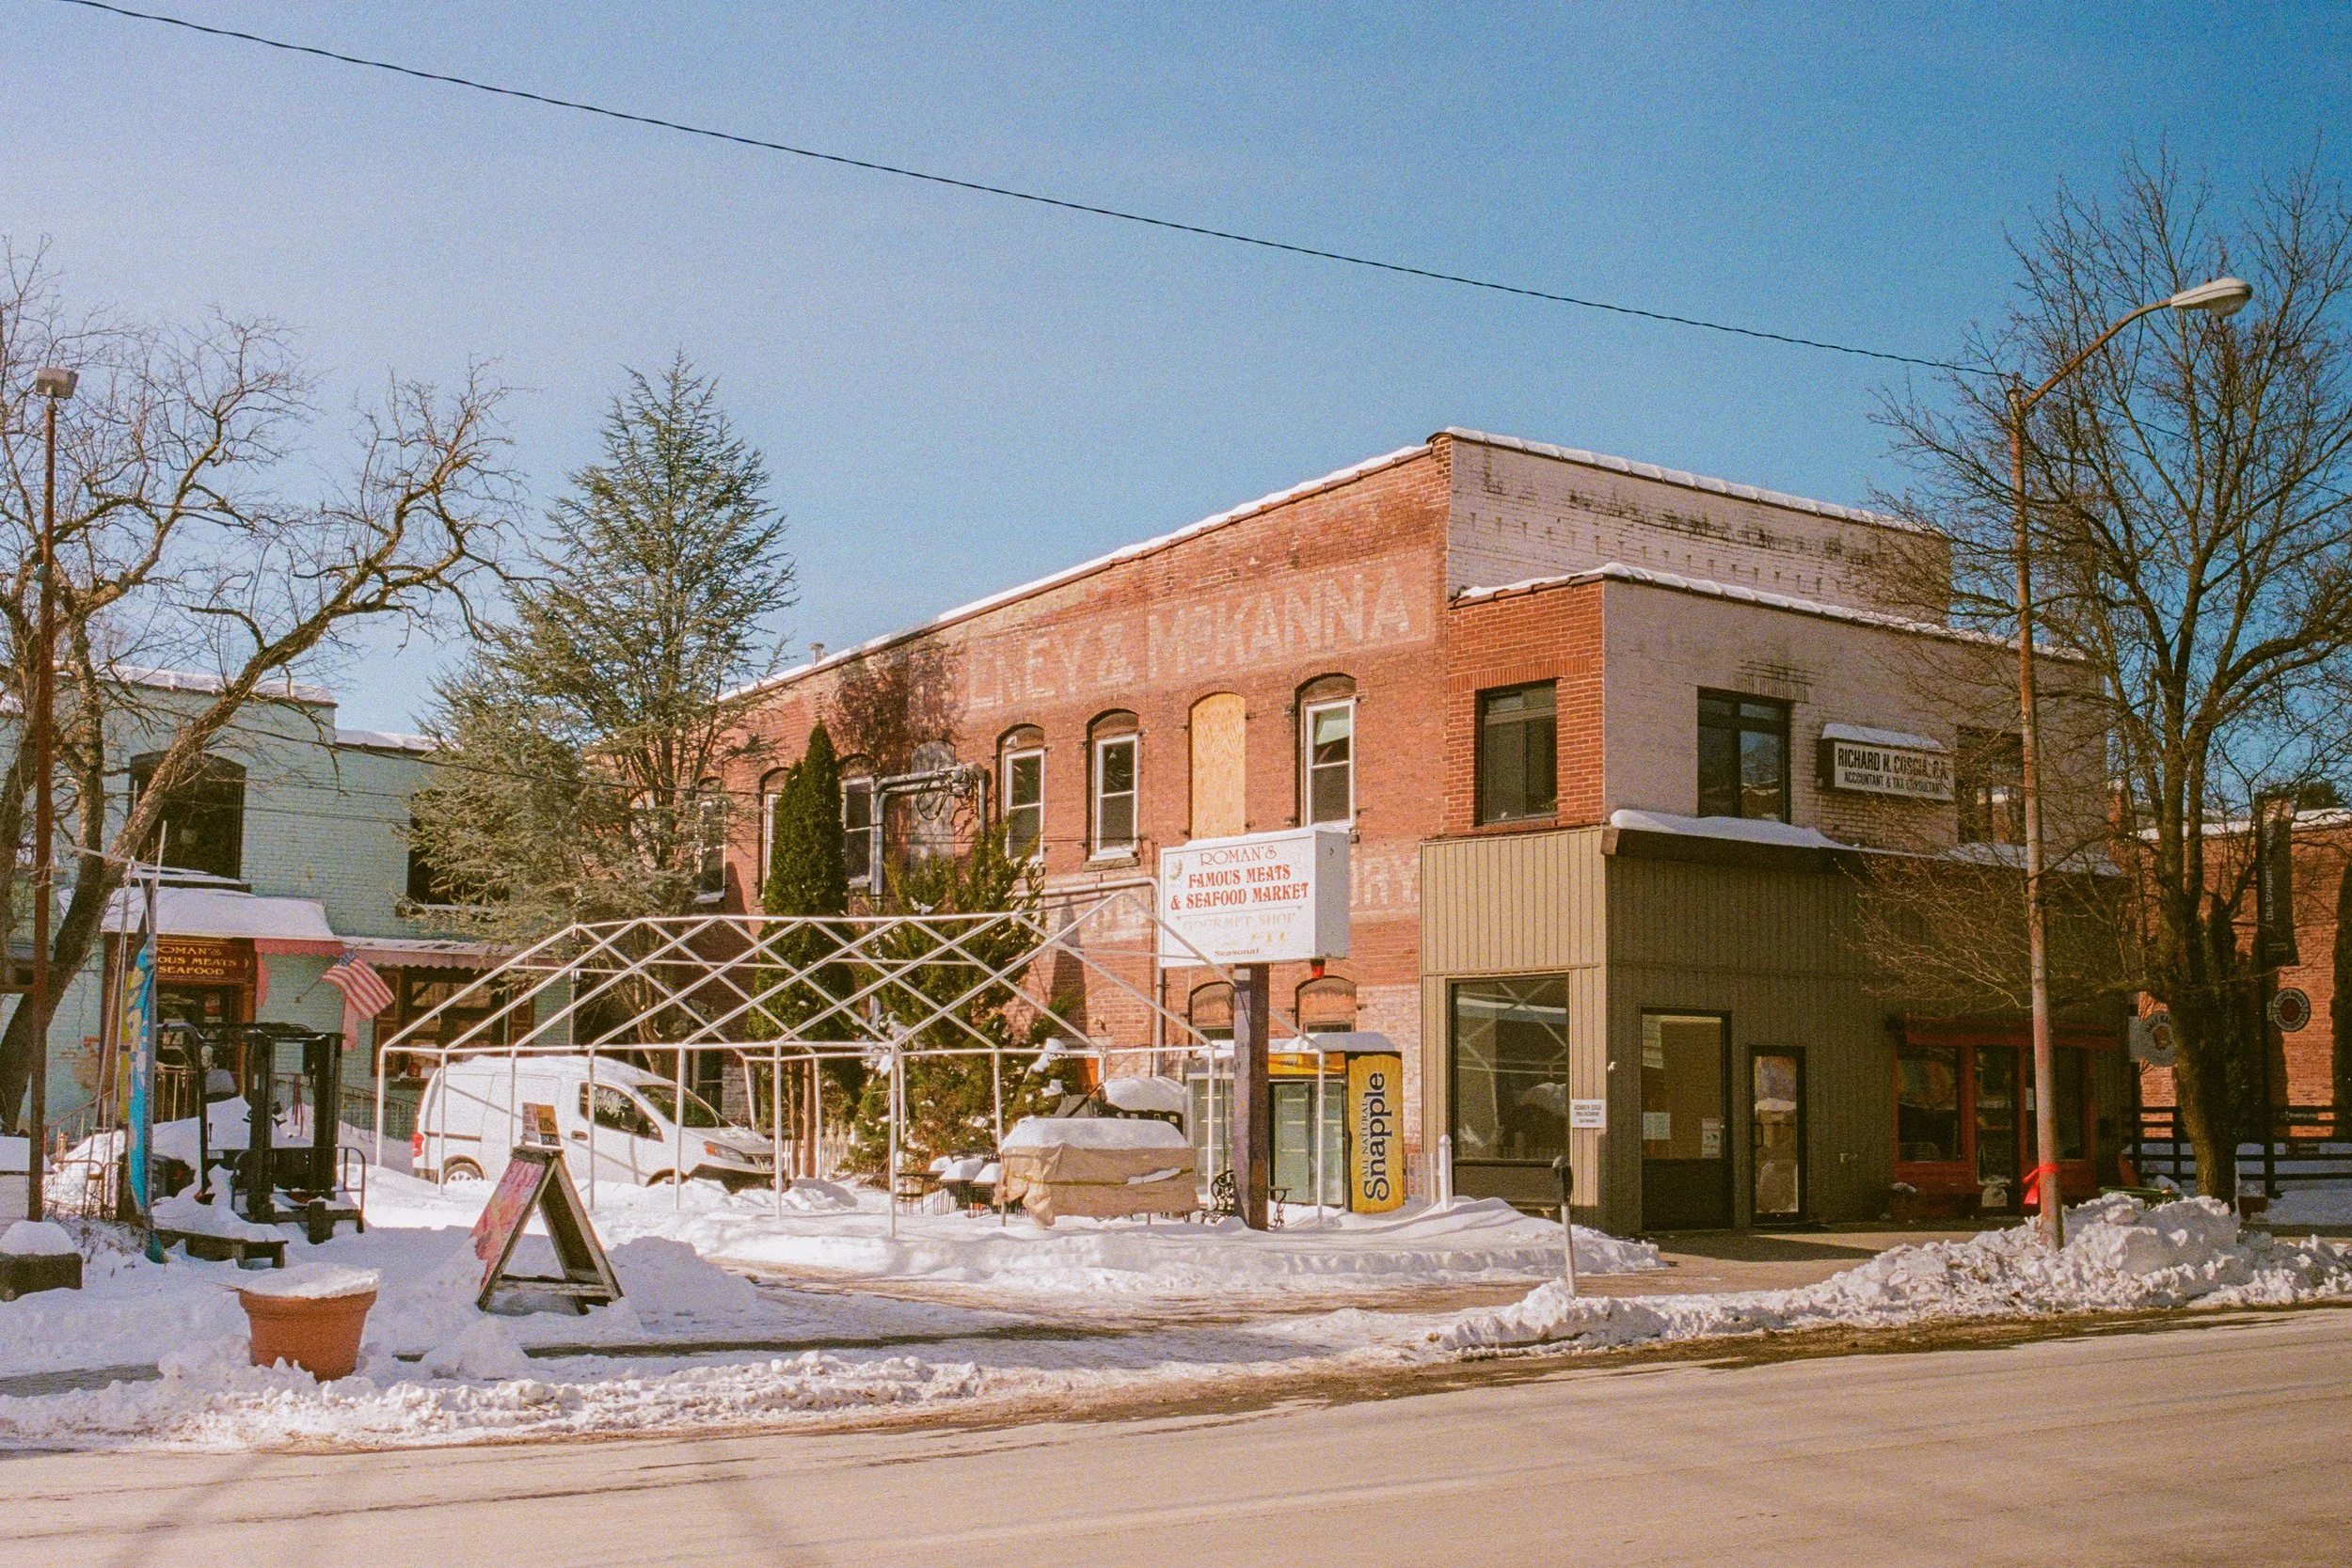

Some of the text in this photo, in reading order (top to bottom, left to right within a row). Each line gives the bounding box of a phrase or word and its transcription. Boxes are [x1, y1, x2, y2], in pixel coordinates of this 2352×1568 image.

[1837, 747, 1880, 771] RICHARD
[1844, 771, 1883, 787] ACCOUNTANT
[1885, 776, 1891, 788] &
[1200, 846, 1278, 866] ROMAN'S
[1188, 864, 1291, 889] FAMOUS MEATS
[1170, 882, 1309, 911] & SEAFOOD MARKET
[156, 946, 222, 956] OMAN'S
[158, 966, 225, 975] SEAFOOD
[191, 958, 237, 967] MEATS
[1364, 1071, 1393, 1202] Snapple
